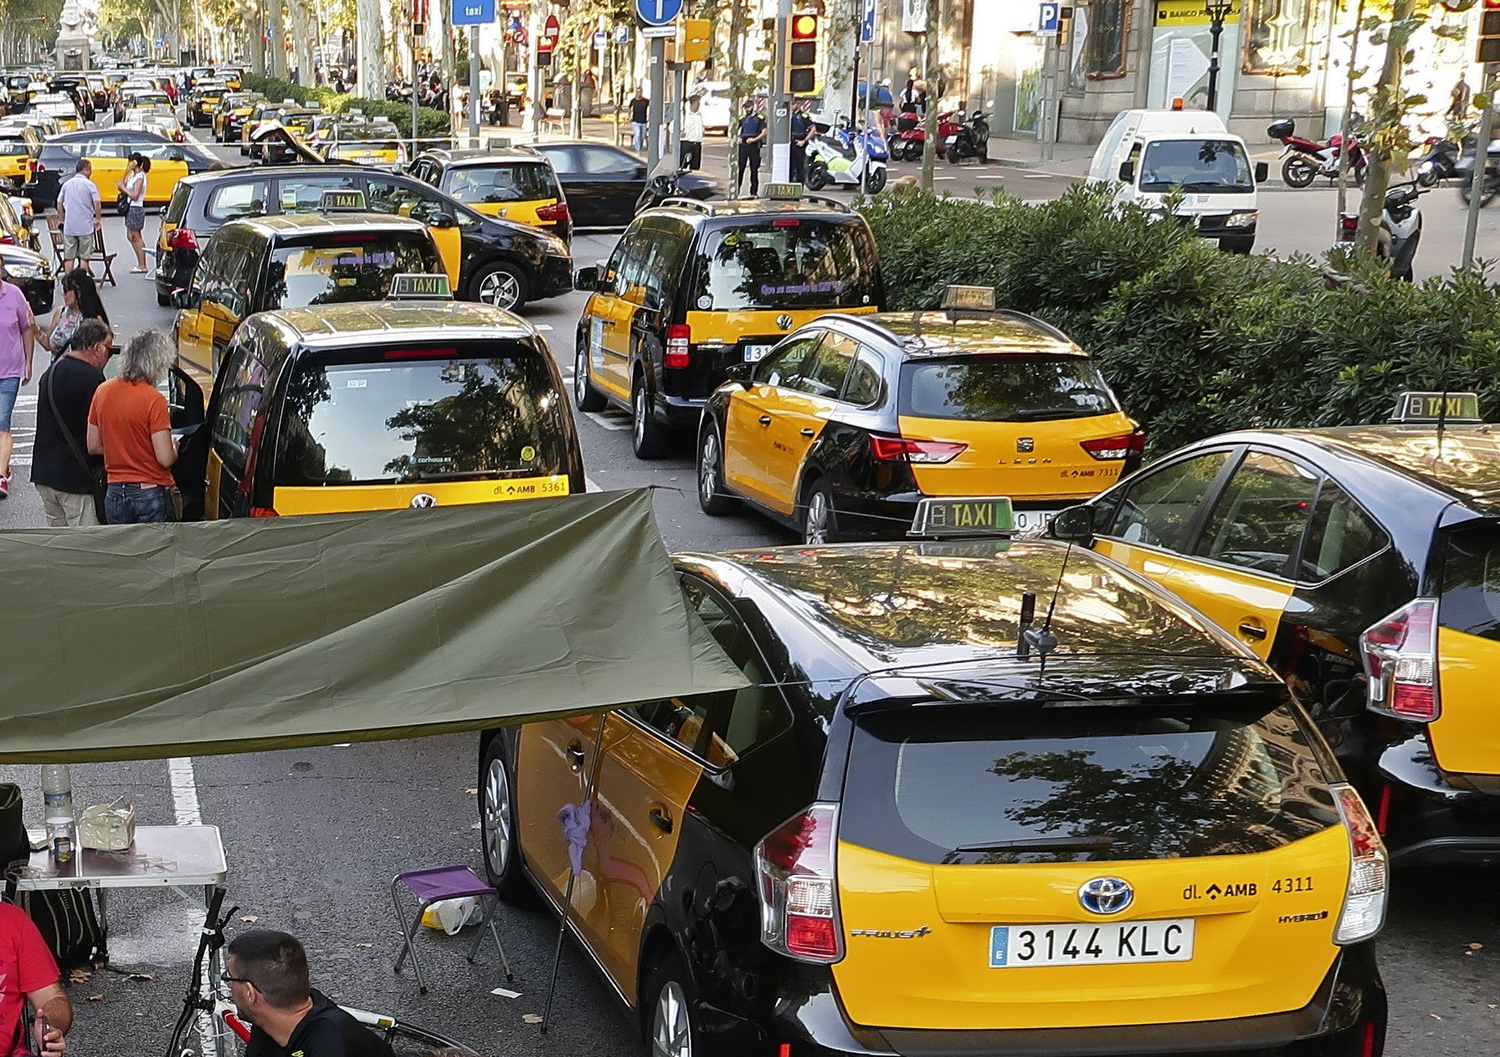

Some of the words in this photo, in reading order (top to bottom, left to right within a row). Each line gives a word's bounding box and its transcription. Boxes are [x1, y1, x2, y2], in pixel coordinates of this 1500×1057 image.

[465, 5, 482, 16] taxi
[1041, 4, 1055, 29] P
[777, 186, 795, 196] TAXI
[336, 195, 356, 206] TAXI
[412, 279, 437, 293] TAXI
[1427, 397, 1461, 416] TAXI
[517, 486, 535, 494] AMB
[542, 482, 566, 492] 5361
[952, 504, 993, 526] TAXI
[1224, 883, 1258, 897] AMB
[1271, 876, 1314, 894] 4311
[1278, 912, 1322, 924] HYBRID
[996, 950, 1003, 960] E
[1017, 928, 1103, 961] 3144
[1118, 924, 1182, 957] KLC
